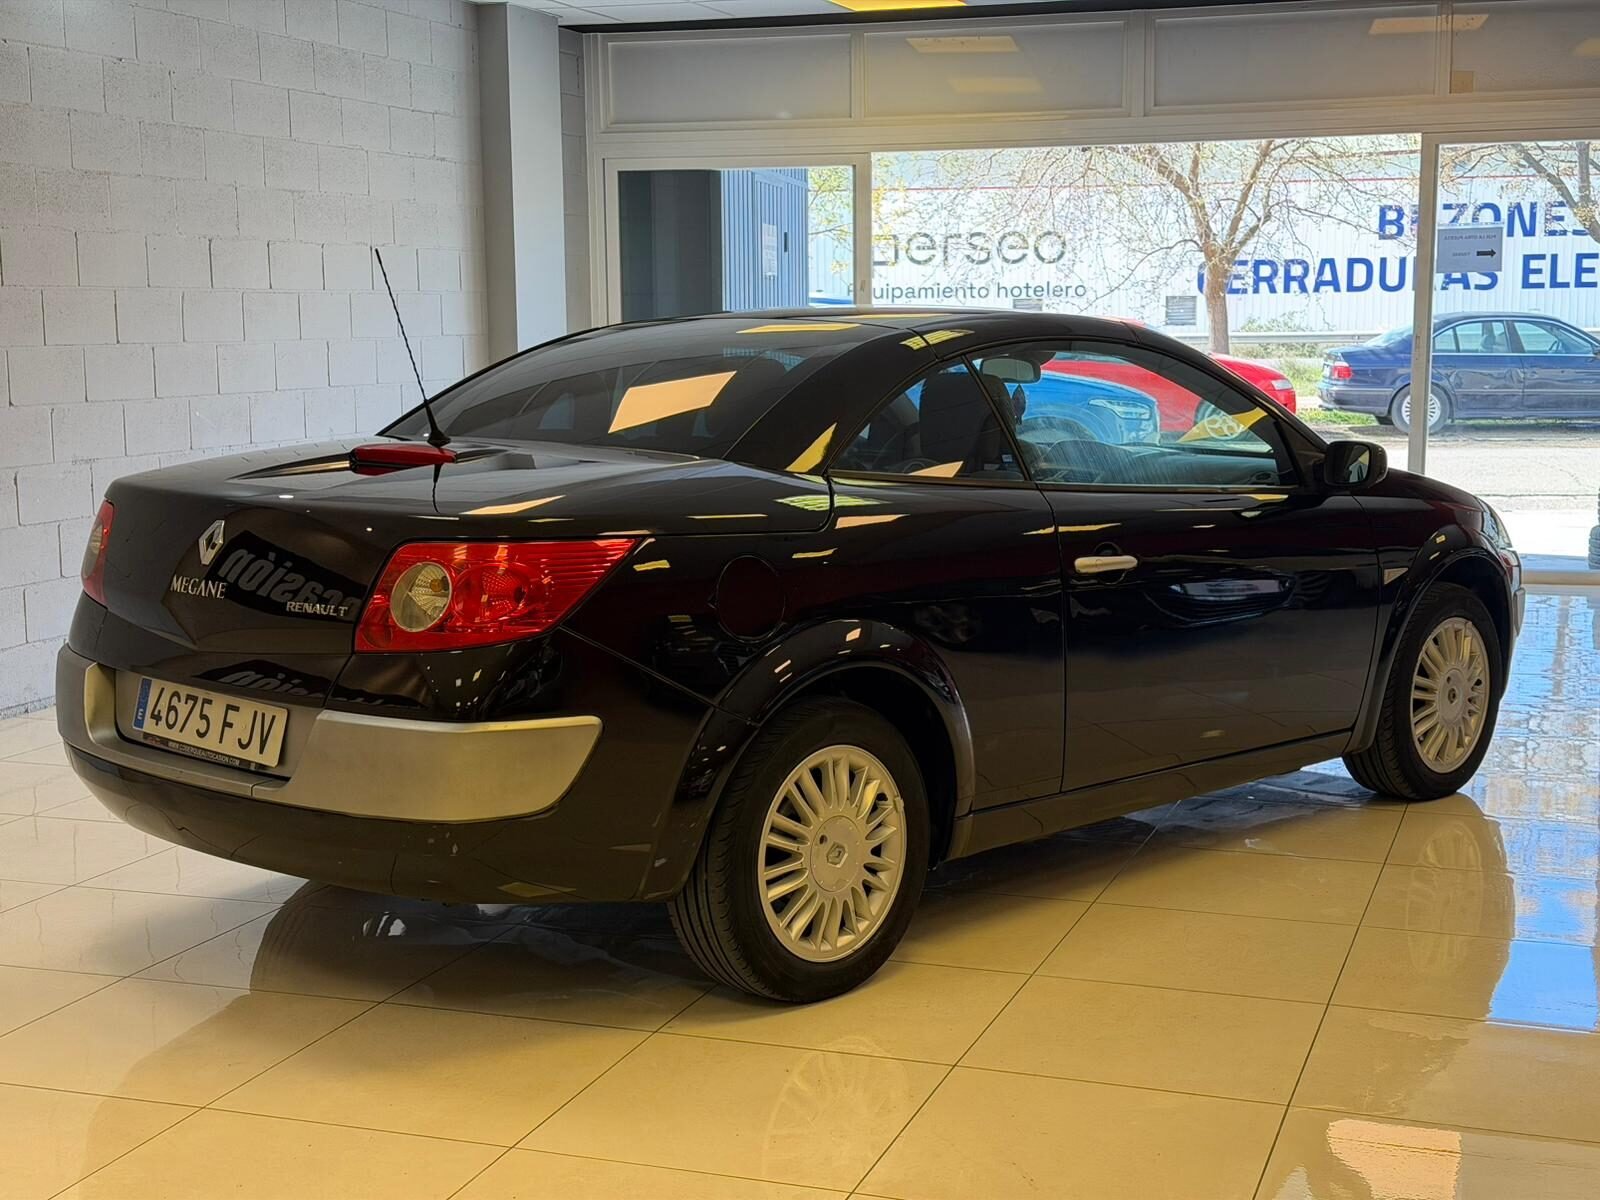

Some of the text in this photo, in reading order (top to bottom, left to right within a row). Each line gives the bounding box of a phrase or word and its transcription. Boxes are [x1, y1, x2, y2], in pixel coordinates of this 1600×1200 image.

[1379, 201, 1589, 240] BZONE
[1197, 253, 1600, 294] ERRADUAS ELE
[996, 281, 1087, 299] hotelero
[170, 574, 228, 599] MEGANE
[286, 601, 348, 617] RENAULT
[150, 687, 213, 739] 4675
[218, 703, 277, 755] FJV
